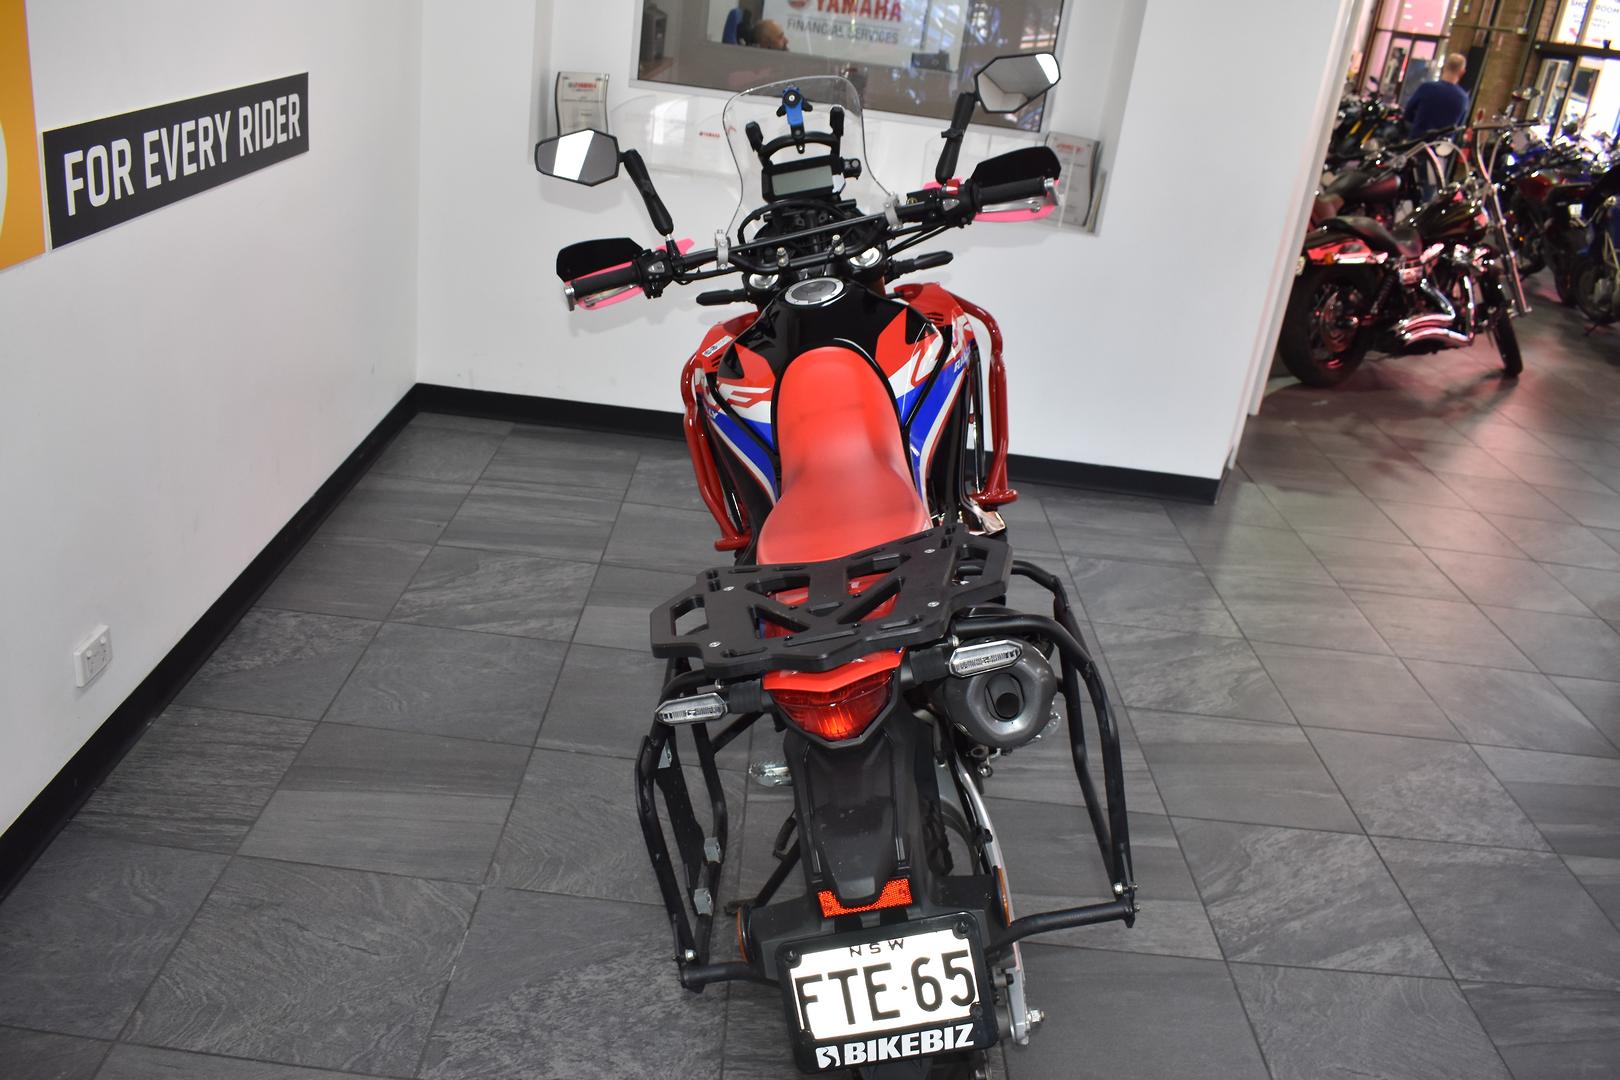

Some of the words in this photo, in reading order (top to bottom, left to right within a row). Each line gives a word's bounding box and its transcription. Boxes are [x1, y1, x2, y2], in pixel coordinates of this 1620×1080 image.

[787, 18, 843, 37] FINANCAL
[64, 138, 135, 217] FOR
[143, 110, 231, 189] EVERY
[238, 93, 301, 157] RIDER
[850, 938, 904, 957] NSW
[844, 1023, 974, 1066] BIKEBIZ
